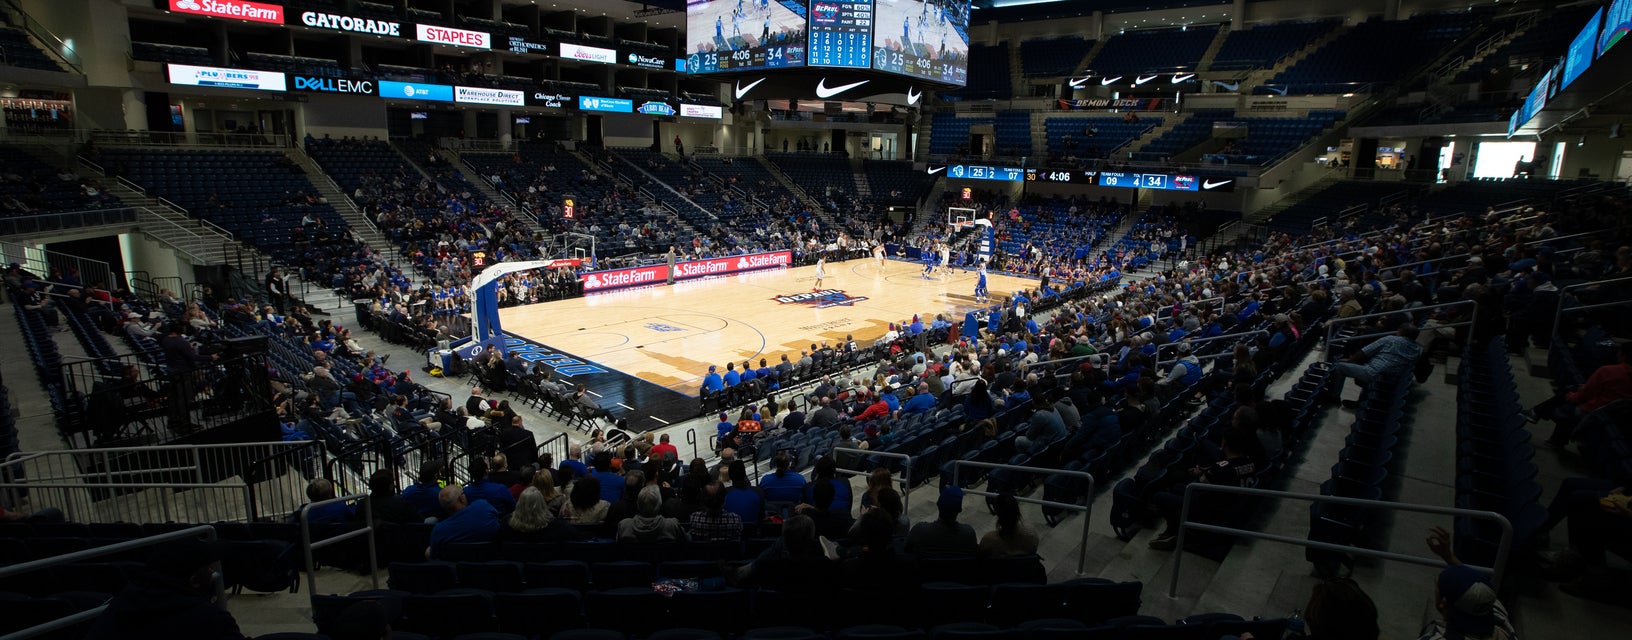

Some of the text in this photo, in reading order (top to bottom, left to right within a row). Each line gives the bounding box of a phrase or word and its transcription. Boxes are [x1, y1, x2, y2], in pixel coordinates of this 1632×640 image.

[302, 12, 400, 36] GATORADE
[427, 28, 482, 46] STAPLES
[732, 49, 750, 61] 4:06
[767, 47, 782, 61] 34
[704, 53, 718, 66] 25
[892, 53, 904, 66] 25
[916, 58, 931, 69] 4:06
[942, 64, 953, 76] 34
[295, 76, 373, 94] DELL EMC
[415, 88, 429, 96] AT&T
[459, 89, 519, 99] WAREHOUSE DIRECT
[1076, 99, 1140, 107] DEMON DECK
[973, 168, 983, 177] 25
[989, 171, 995, 179] 2
[1008, 172, 1018, 180] 07
[1026, 173, 1036, 181] 30
[1049, 171, 1070, 181] 4:06
[1106, 177, 1118, 185] 09
[1133, 178, 1139, 186] 4
[1148, 177, 1161, 186] 34
[963, 191, 971, 199] 30
[565, 206, 573, 218] 30
[474, 258, 483, 266] 30
